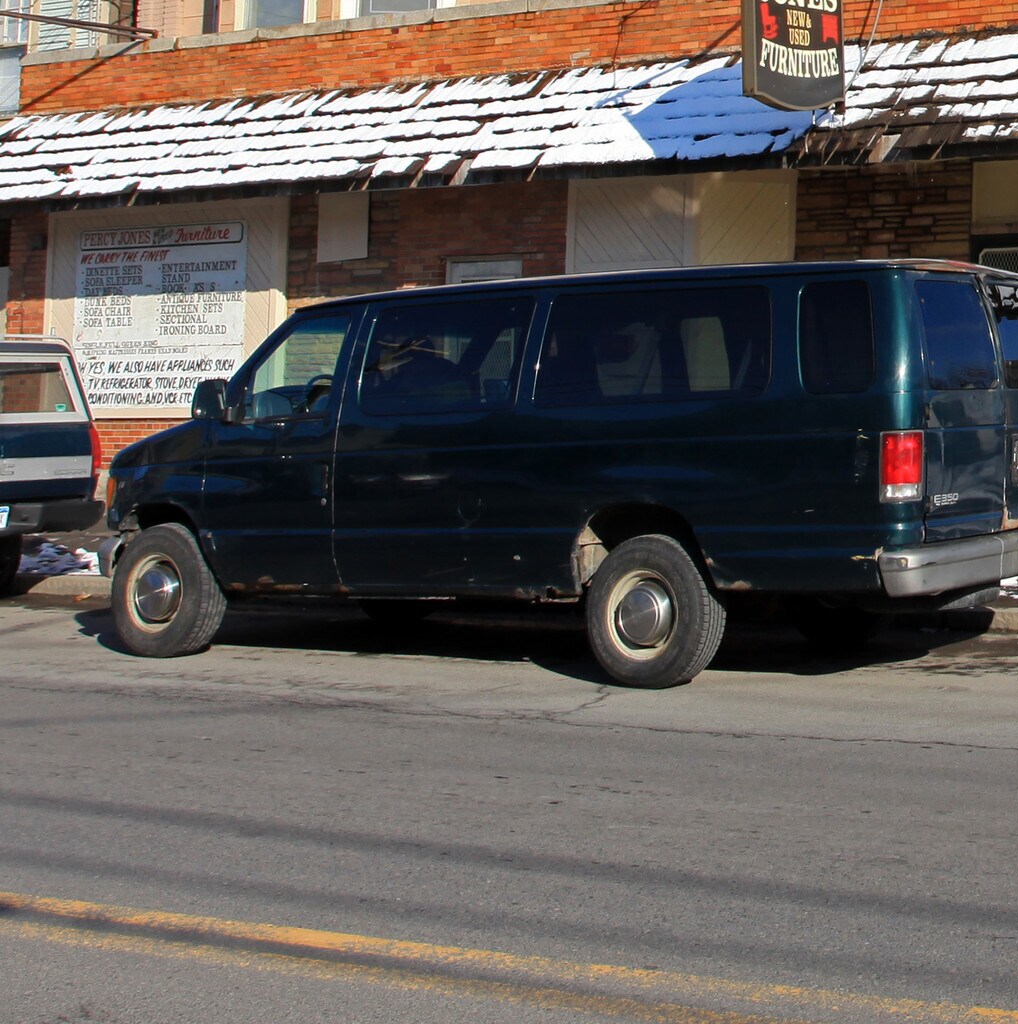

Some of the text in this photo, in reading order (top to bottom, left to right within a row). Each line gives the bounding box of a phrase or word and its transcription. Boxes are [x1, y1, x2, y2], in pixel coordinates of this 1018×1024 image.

[789, 28, 810, 46] USED
[759, 38, 839, 78] FURNITURE
[84, 230, 151, 247] PERCY JONES
[174, 226, 231, 244] Furniture
[80, 249, 170, 265] WE CARRY THE FINEST
[85, 265, 143, 277] DINETTE SETS
[161, 260, 237, 274] ENTERTAINMENT
[85, 275, 143, 287] SOFA SLEEPER
[162, 272, 191, 284] STAND
[84, 287, 101, 297] DAY
[110, 297, 132, 306] BEDS
[160, 293, 195, 305] ANTIQUE
[83, 307, 132, 317] SOFA CHAIR
[160, 303, 223, 315] KITCHEN SETS
[83, 317, 133, 328] SOFA TABLE
[160, 314, 207, 325] SECTIONAL
[158, 325, 227, 336] IRONING BOARD
[88, 361, 106, 376] YES,
[107, 361, 124, 374] WE
[124, 359, 144, 373] ALSO
[144, 359, 166, 372] HAVE
[166, 358, 213, 373] APPLIANCES
[214, 358, 235, 372] SUCH
[933, 492, 959, 504] E350
